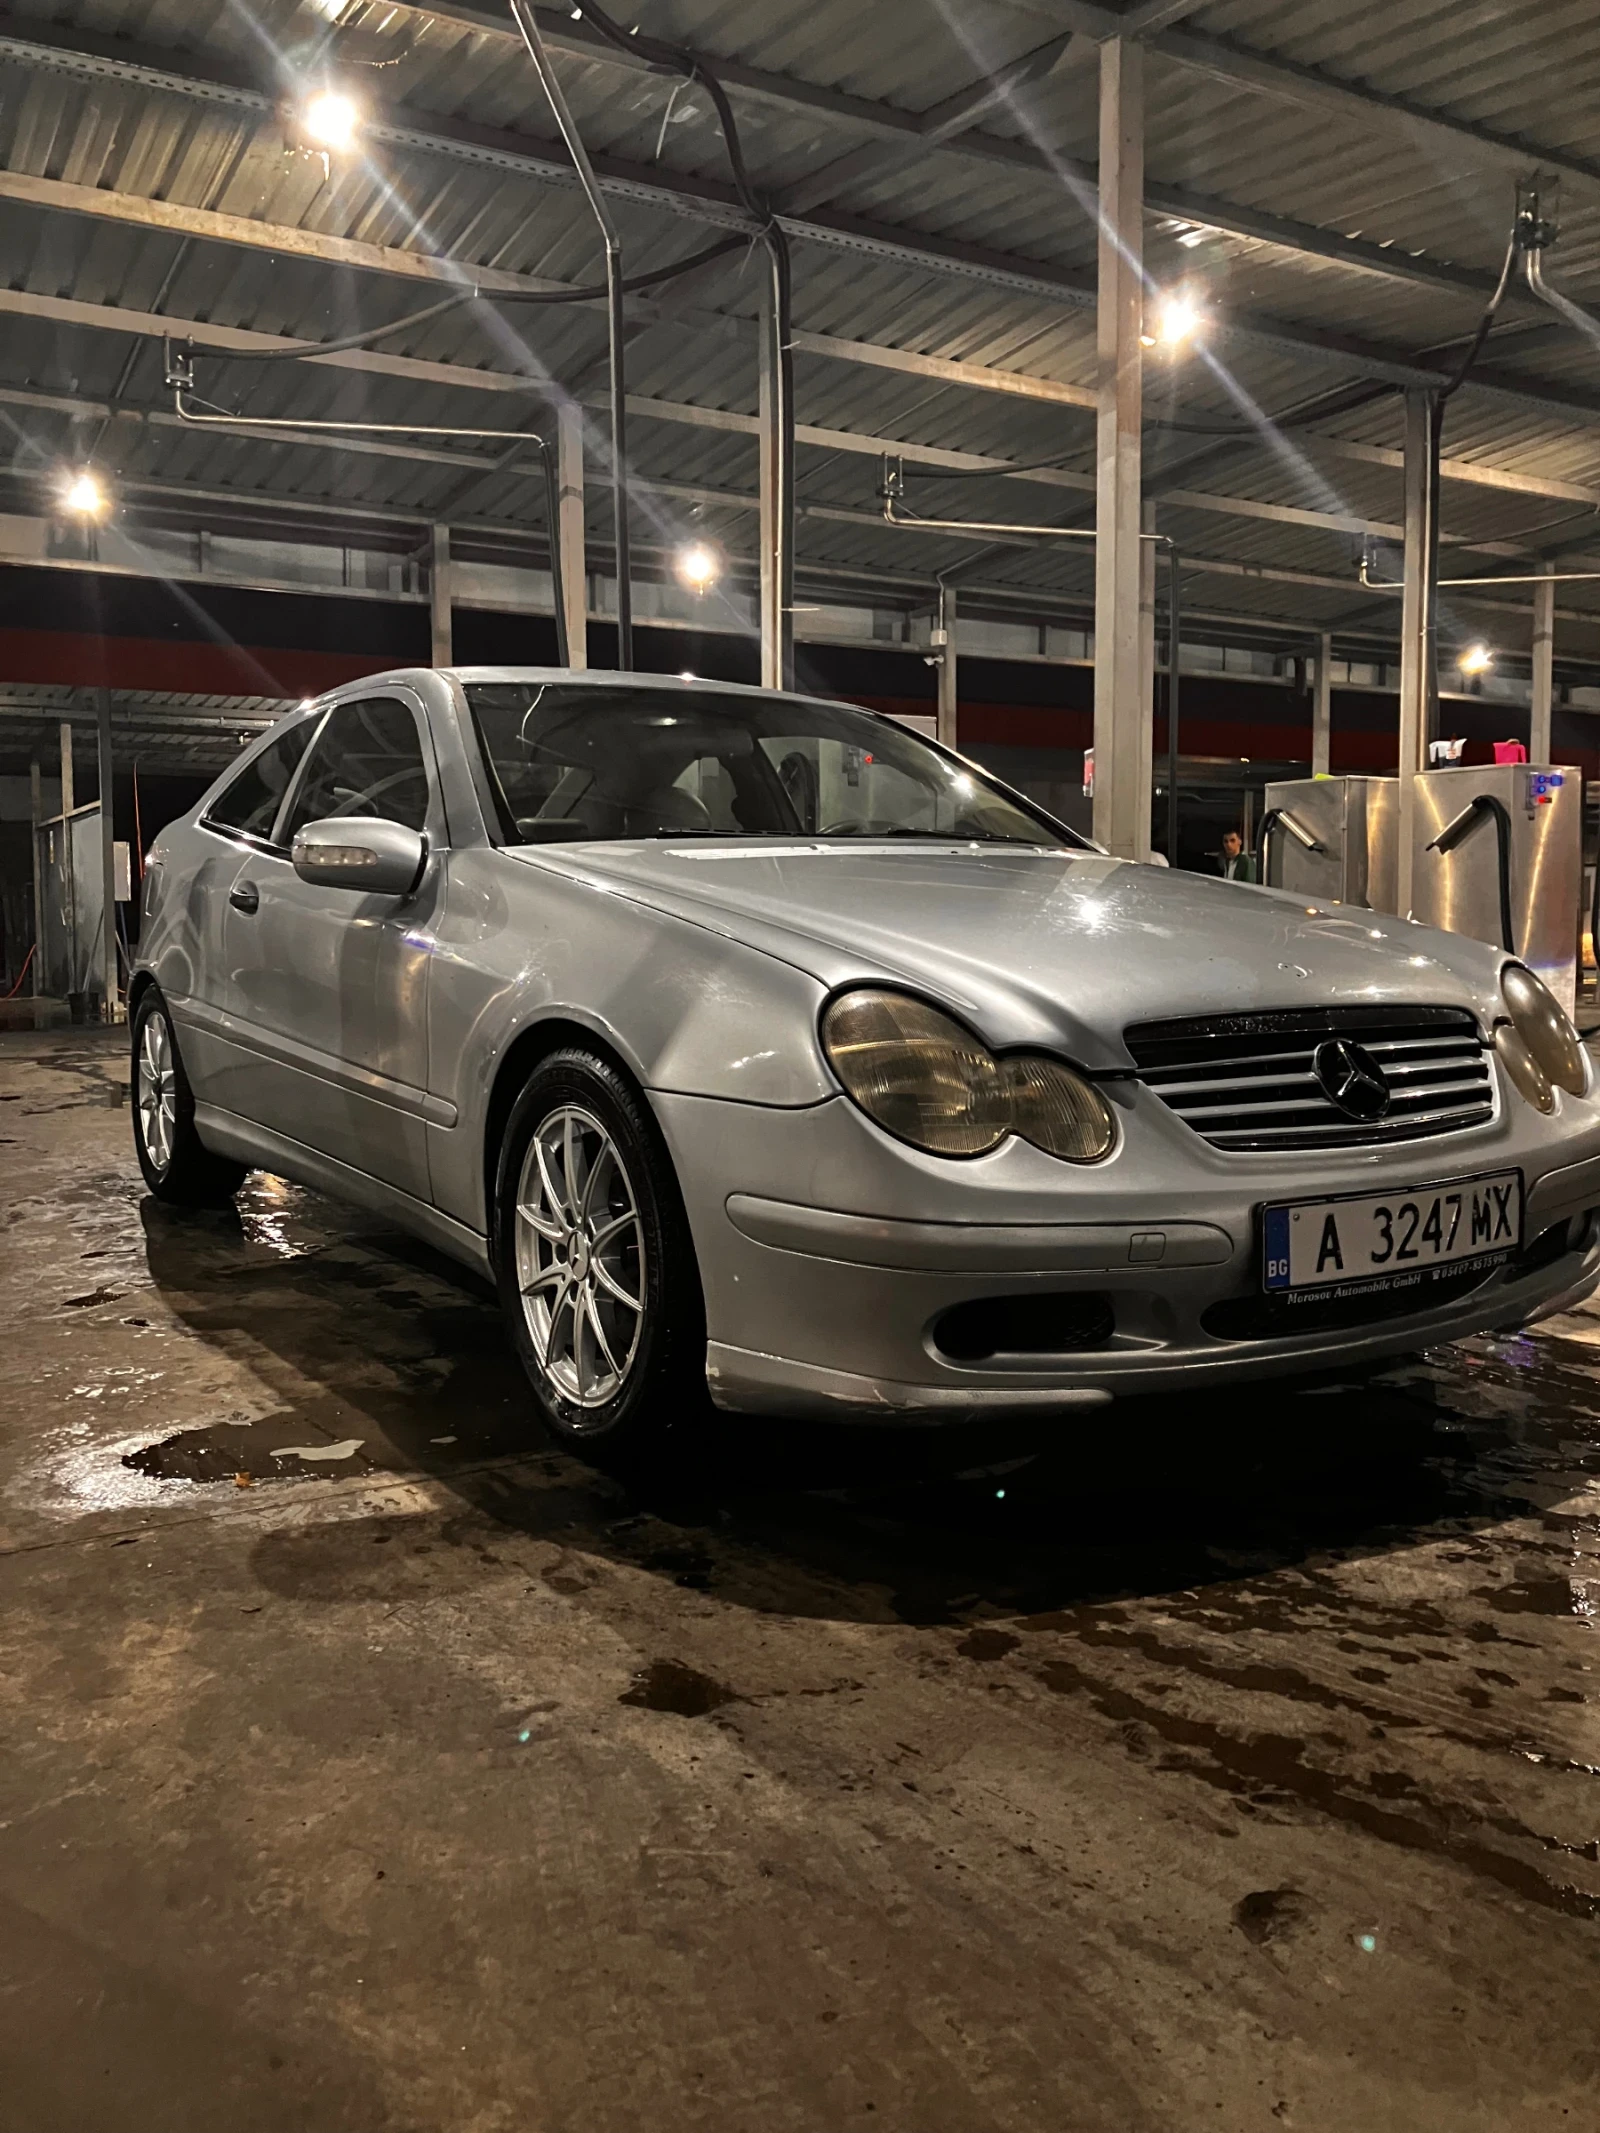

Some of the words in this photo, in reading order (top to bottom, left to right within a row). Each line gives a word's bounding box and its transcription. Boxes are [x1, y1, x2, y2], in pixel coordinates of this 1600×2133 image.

[1316, 1213, 1344, 1273] A
[1371, 1194, 1462, 1264] 3247
[1471, 1184, 1513, 1246] MX
[1268, 1259, 1288, 1278] BG
[1334, 1280, 1390, 1299] Automobile
[1393, 1273, 1422, 1288] GmbH
